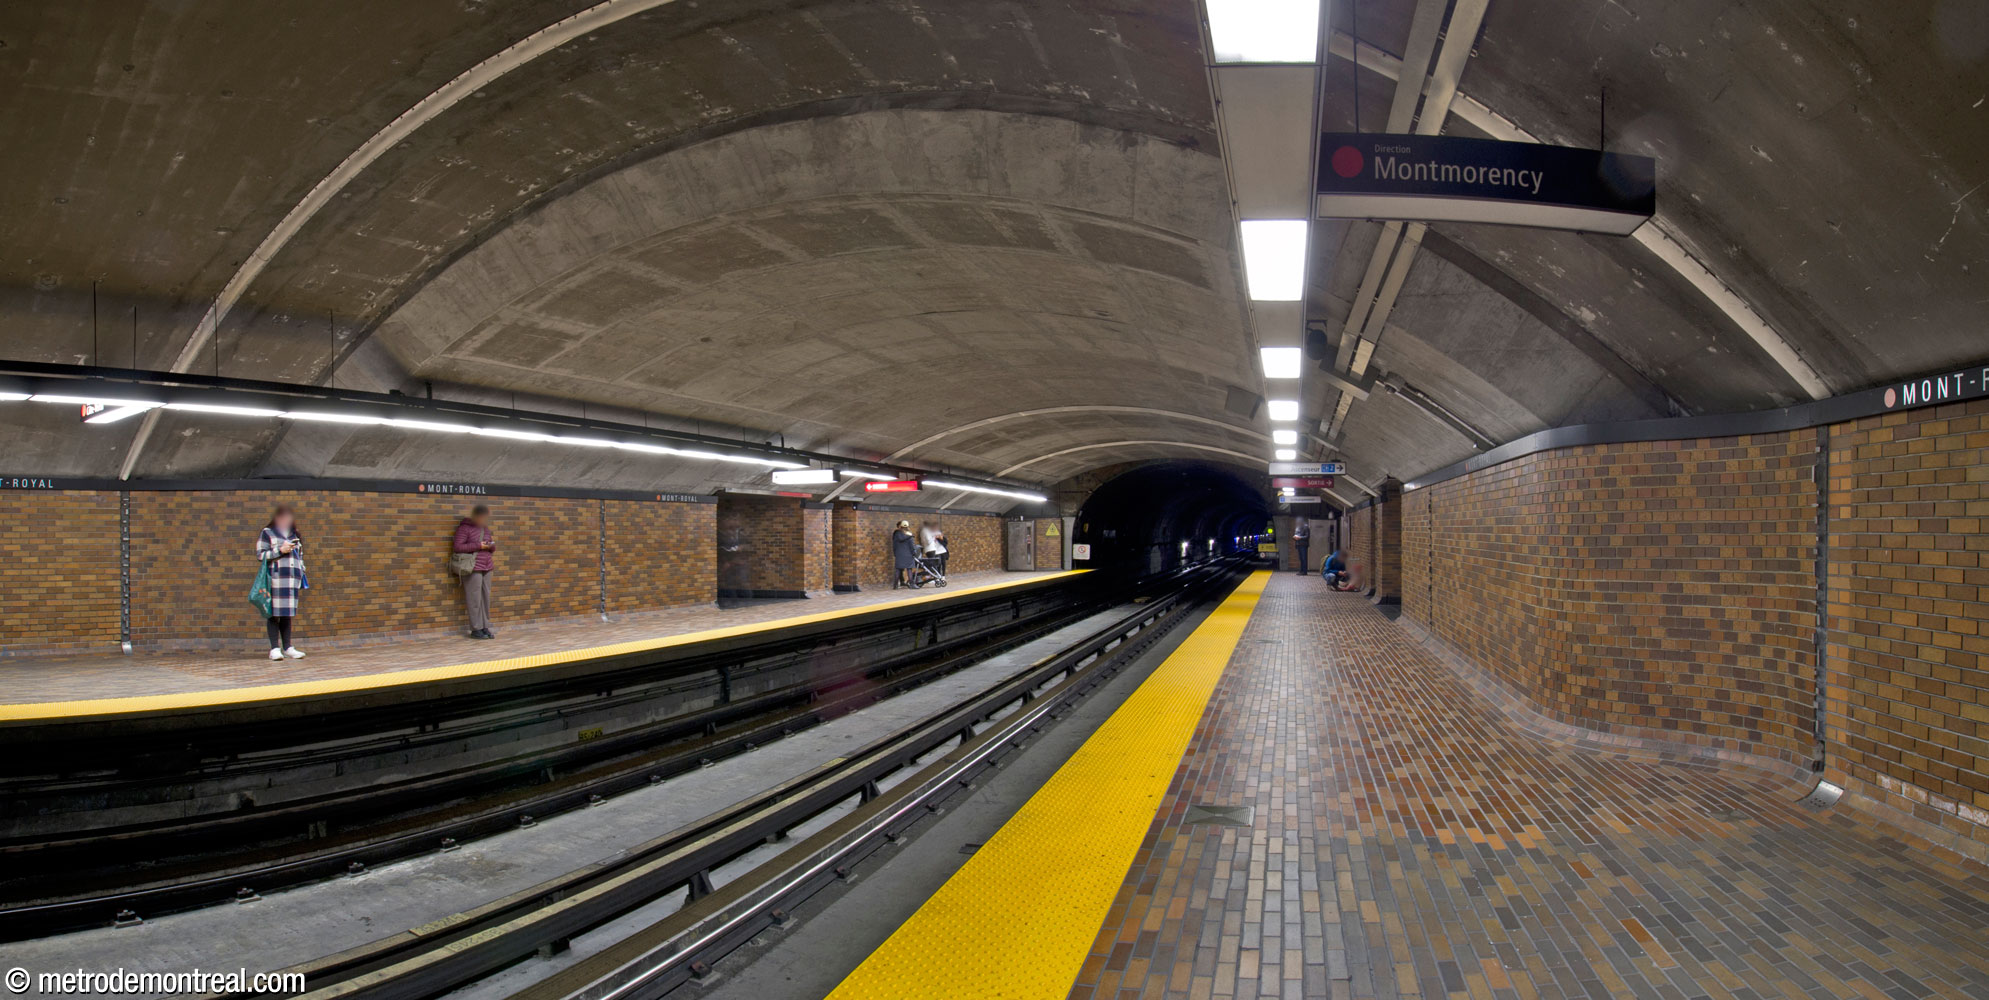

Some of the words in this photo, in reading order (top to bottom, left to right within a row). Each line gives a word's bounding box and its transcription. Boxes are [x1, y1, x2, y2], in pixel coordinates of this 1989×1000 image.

[1374, 144, 1412, 154] Direction
[1374, 156, 1544, 194] Montmorency
[427, 484, 487, 494] MONT-ROYAL
[661, 494, 698, 503] MONT-ROYAL
